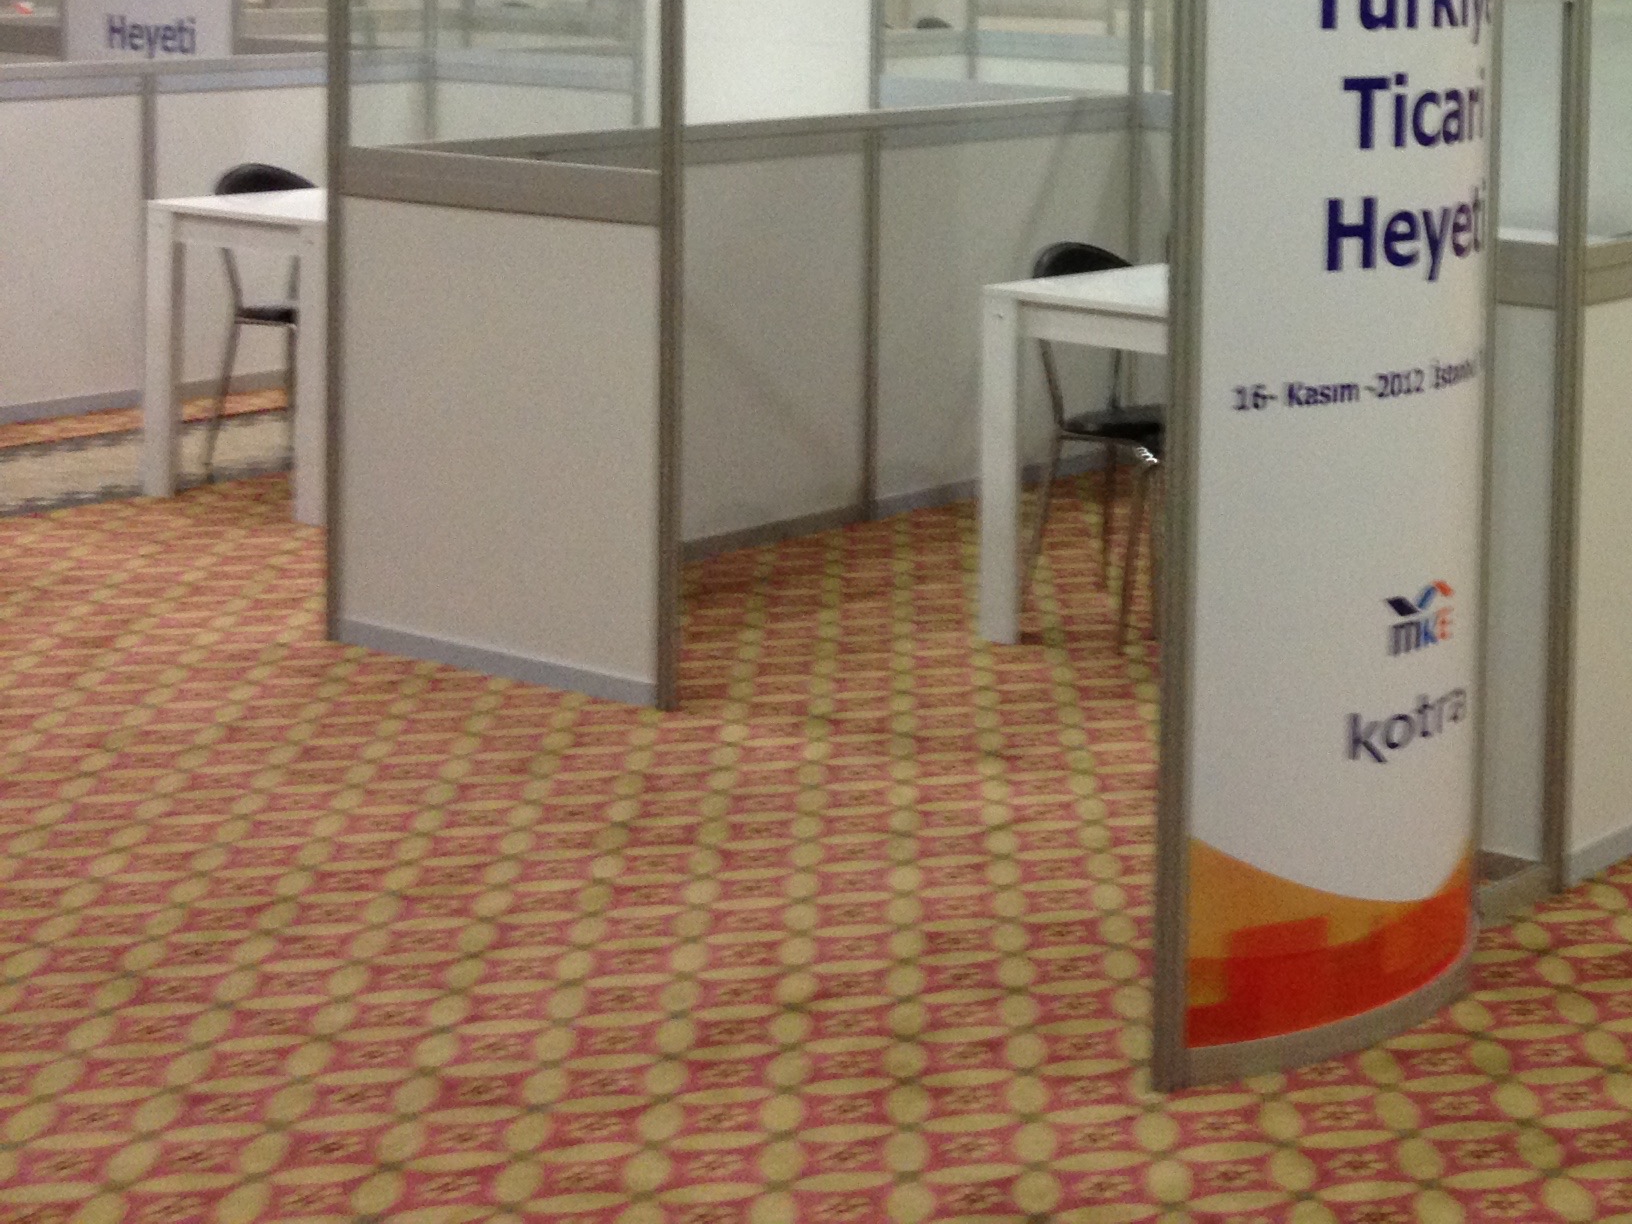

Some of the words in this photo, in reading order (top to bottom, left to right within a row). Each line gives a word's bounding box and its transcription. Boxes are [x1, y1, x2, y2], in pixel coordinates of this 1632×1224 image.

[107, 13, 197, 59] Heyeti
[1342, 68, 1485, 150] Ticari
[1324, 181, 1487, 282] Heyeti
[1344, 687, 1468, 764] kotra
